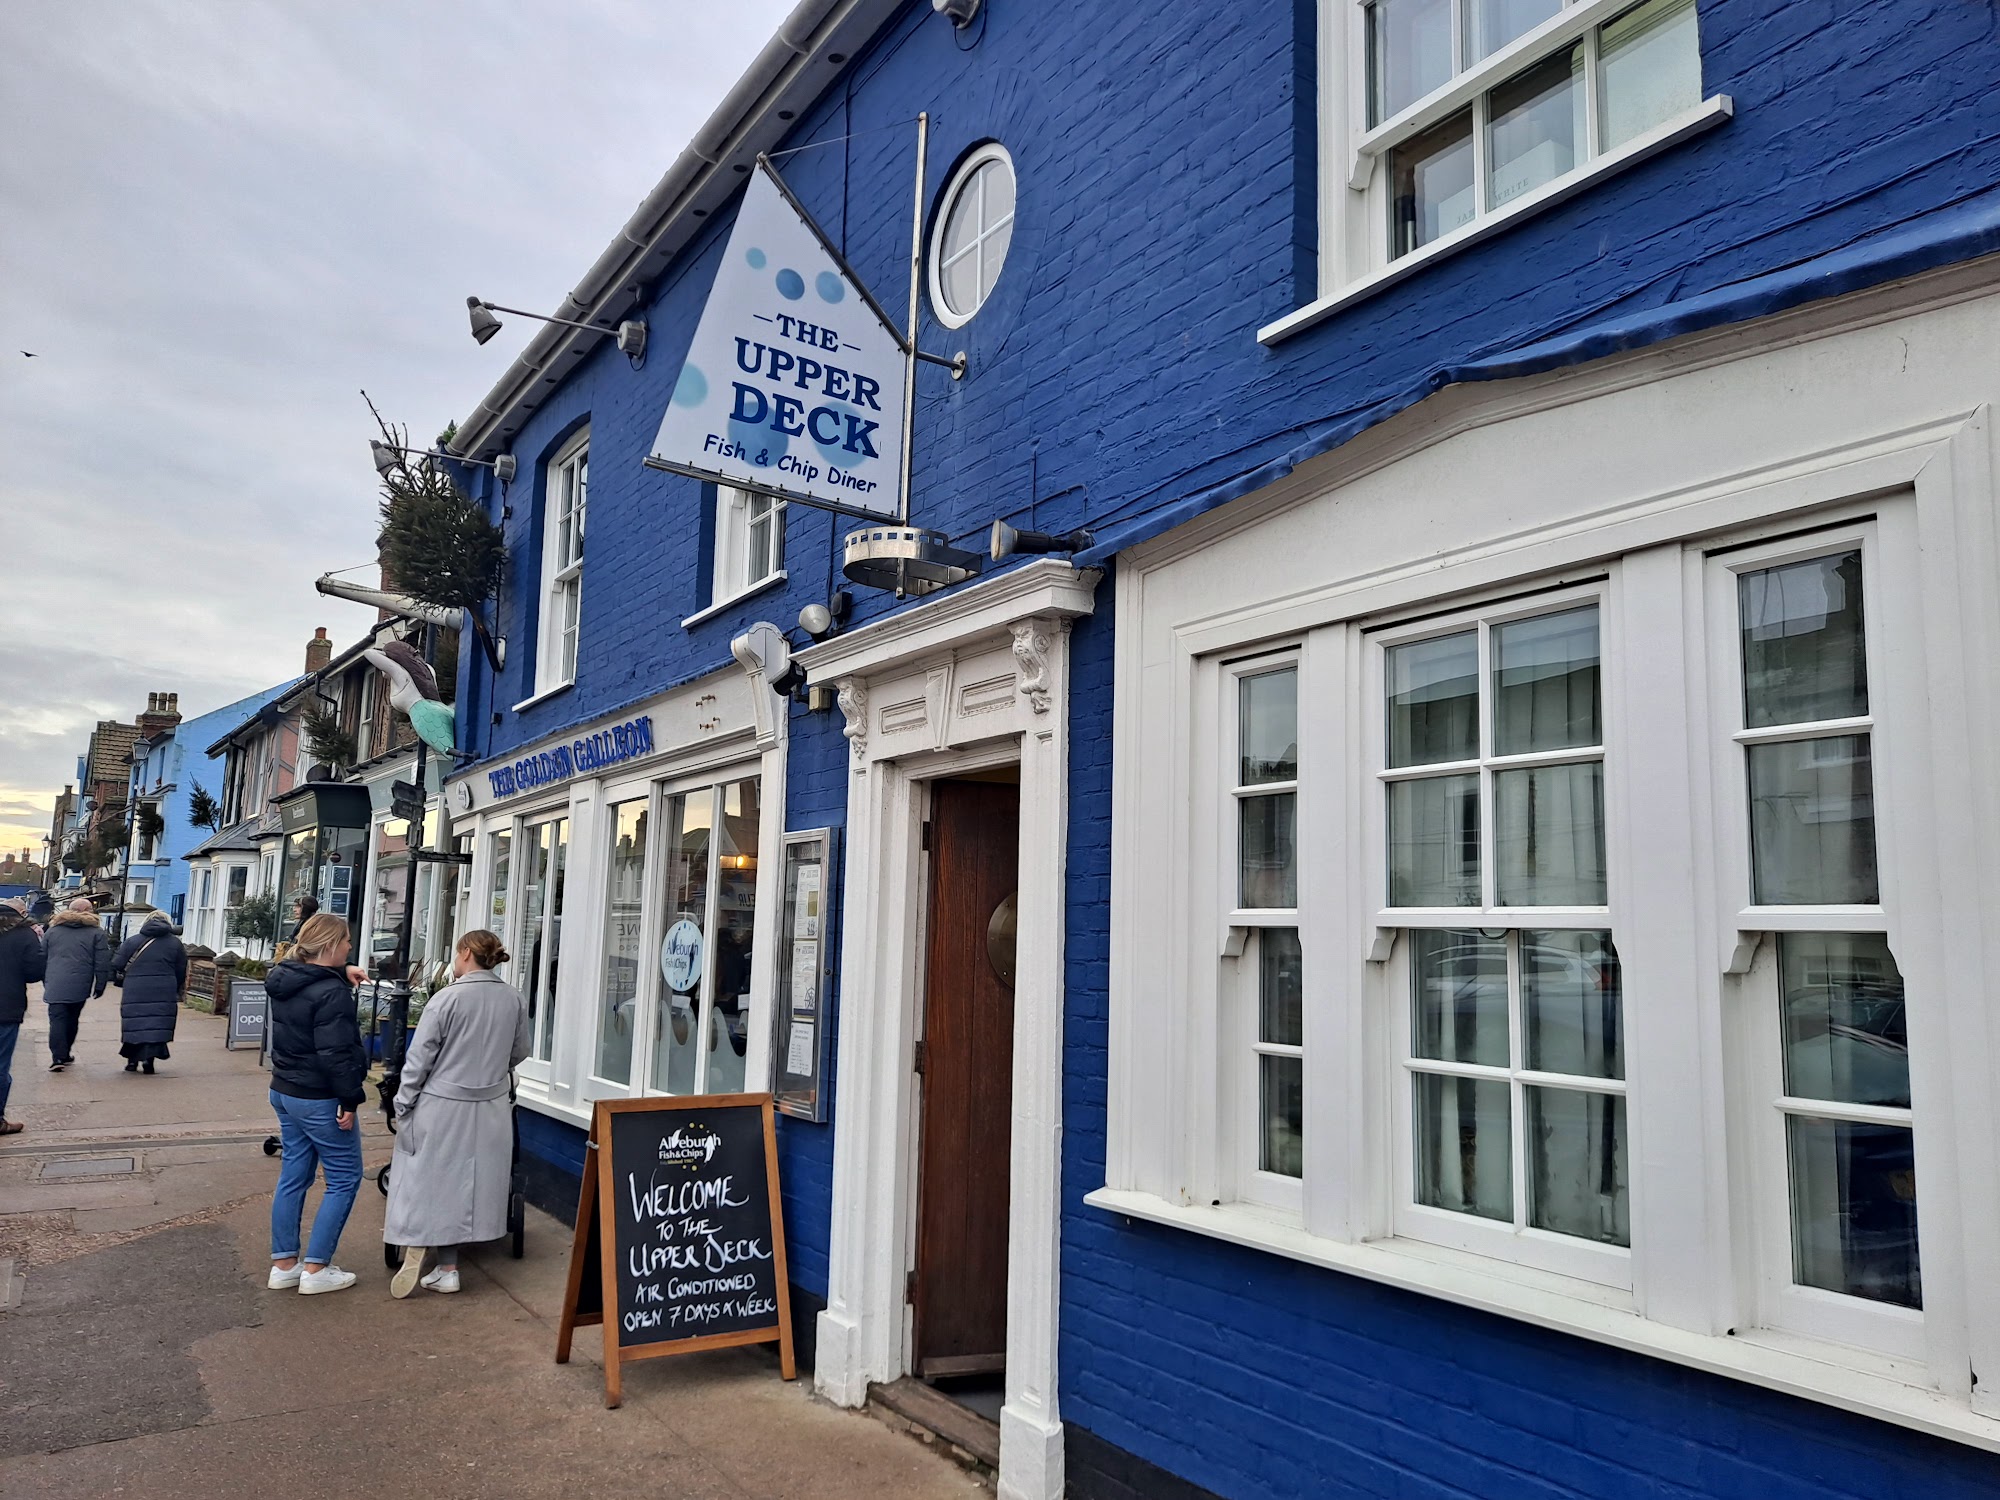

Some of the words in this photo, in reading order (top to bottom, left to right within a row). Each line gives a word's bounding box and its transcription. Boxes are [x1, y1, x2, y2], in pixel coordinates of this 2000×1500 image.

[1495, 178, 1529, 201] WHITE
[776, 313, 839, 353] THE
[735, 336, 881, 411] UPPER
[729, 381, 879, 459] DECK
[703, 433, 746, 461] Fish
[754, 448, 768, 467] &
[778, 455, 819, 481] Chip
[827, 466, 877, 494] Diner
[489, 766, 515, 798] THE
[515, 745, 573, 789] GOLDEN
[574, 715, 652, 771] GALLEON
[240, 1014, 264, 1025] ope
[629, 1170, 749, 1223] WELCOME
[656, 1222, 674, 1241] TO
[678, 1217, 723, 1237] THE
[630, 1243, 700, 1277] UPPER
[704, 1235, 772, 1273] DECK
[635, 1283, 664, 1303] AIR
[668, 1273, 755, 1299] CONDITIONED
[624, 1309, 662, 1332] OPEN
[670, 1306, 680, 1327] 7
[685, 1304, 720, 1324] DAYS
[722, 1304, 734, 1317] A
[737, 1292, 776, 1316] WEEK
